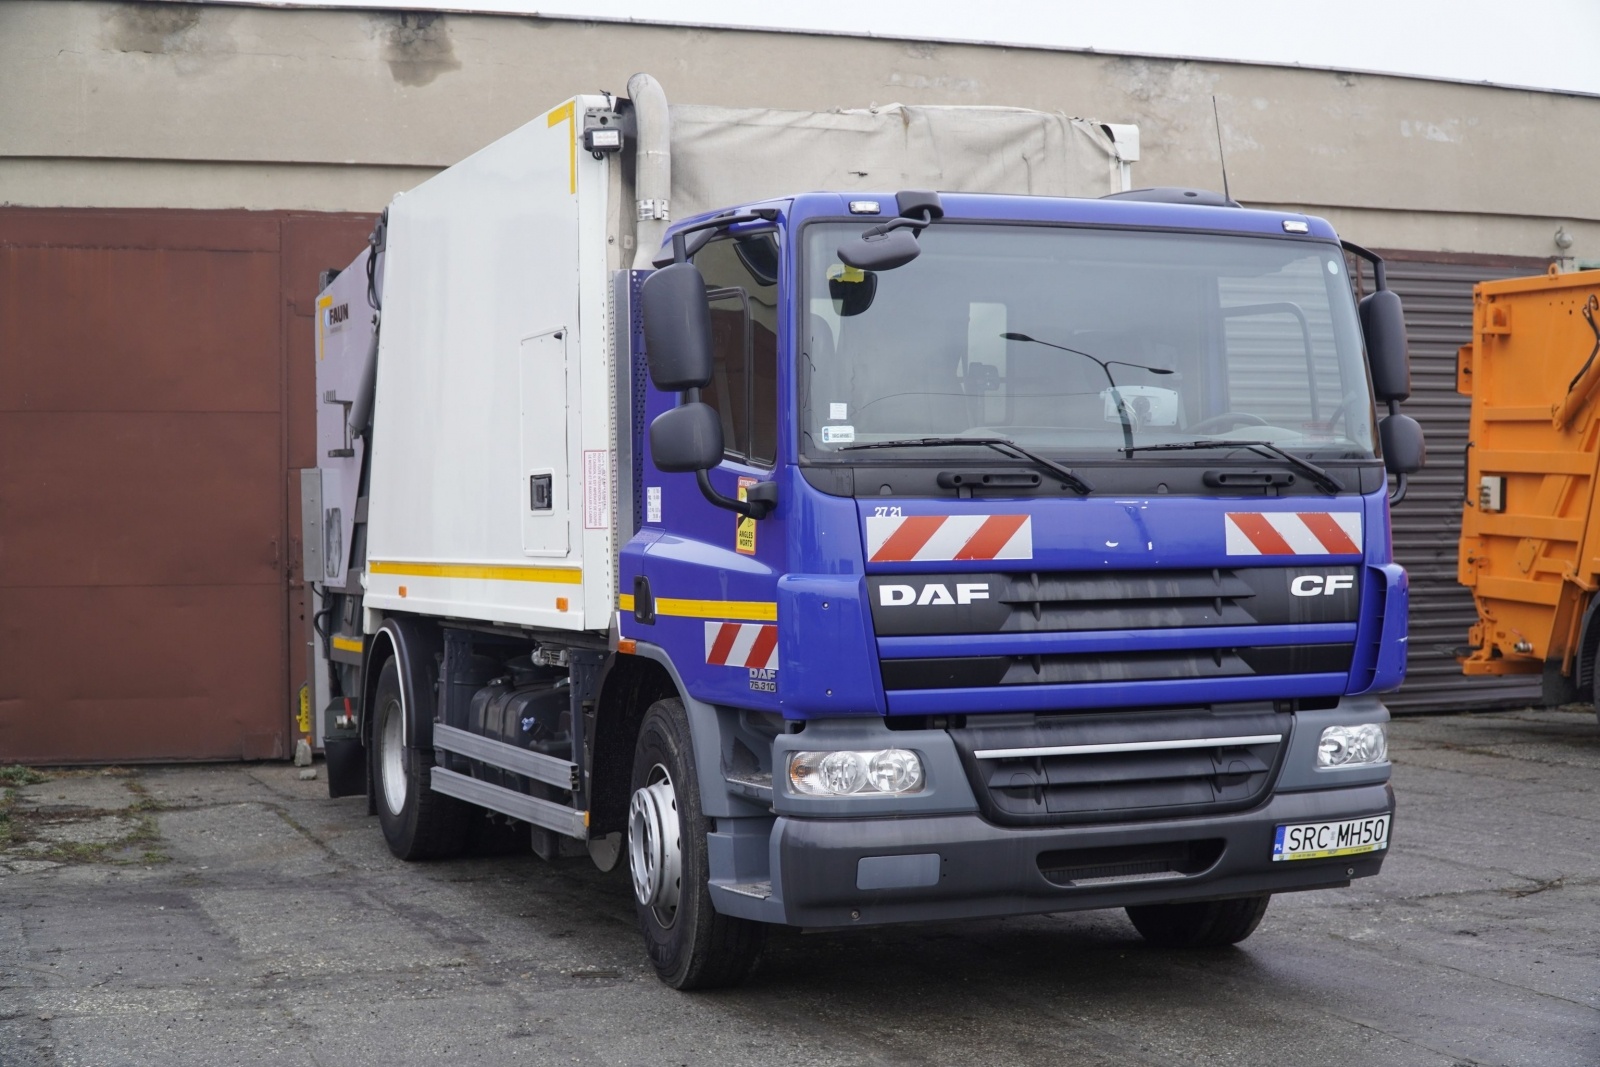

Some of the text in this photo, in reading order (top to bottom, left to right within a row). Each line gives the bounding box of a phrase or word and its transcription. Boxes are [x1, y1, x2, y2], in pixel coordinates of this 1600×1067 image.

[330, 303, 348, 325] FAUN
[874, 506, 902, 517] 27 21
[739, 530, 754, 539] ANGLES
[740, 538, 752, 548] MORTS
[1290, 575, 1354, 596] CF
[879, 583, 990, 606] DAF
[750, 668, 776, 680] DAF
[1288, 819, 1384, 851] SRC MH50
